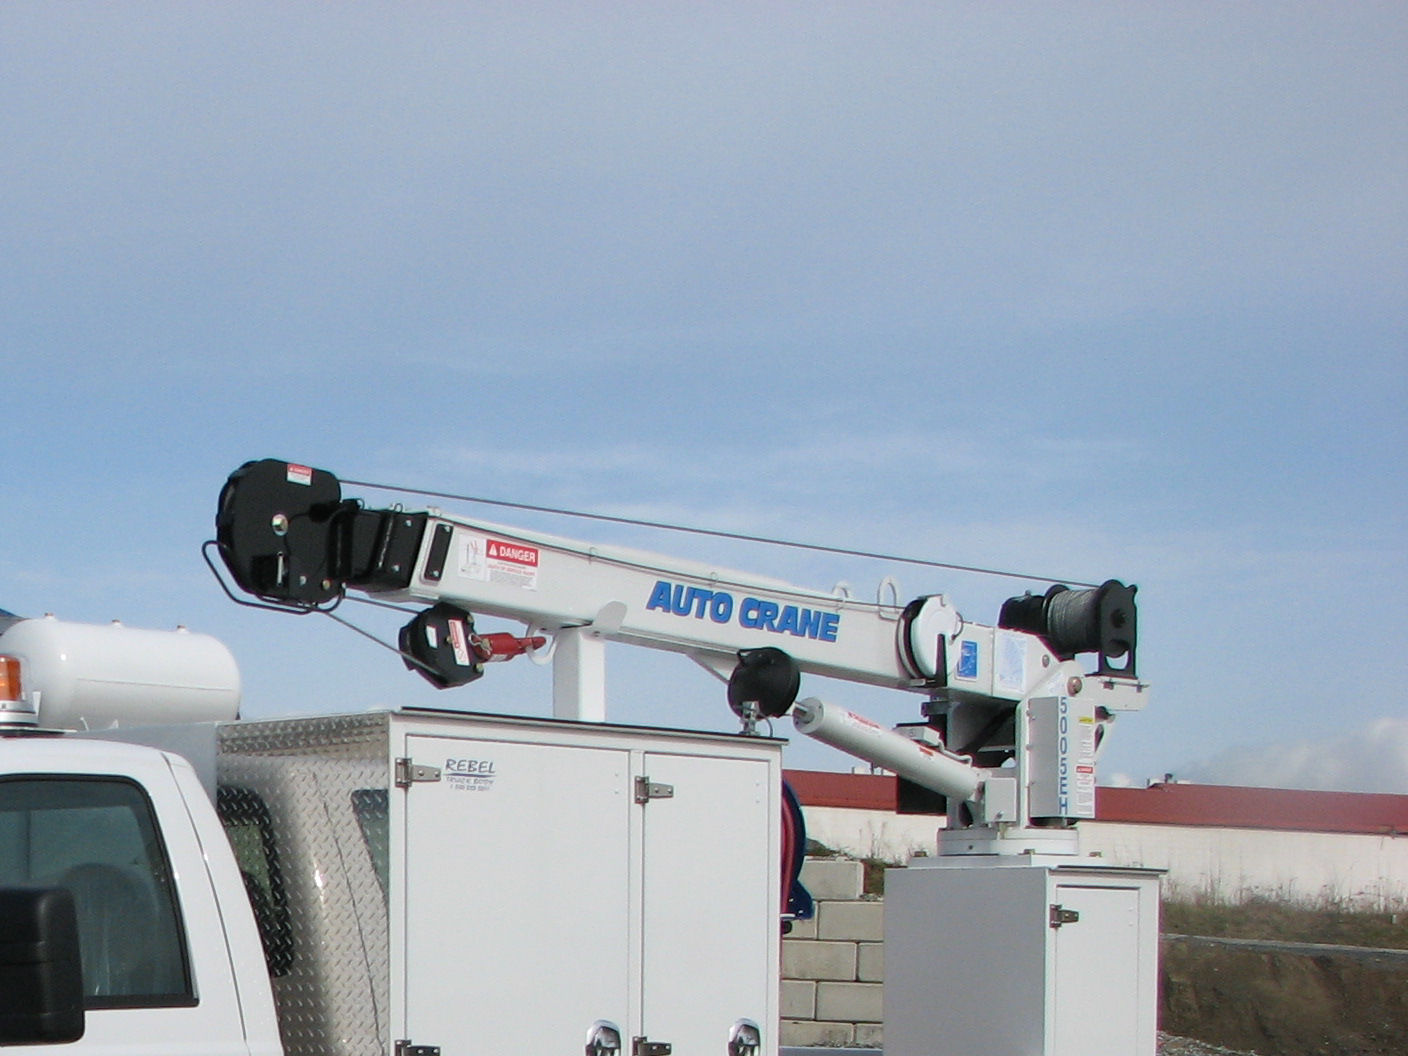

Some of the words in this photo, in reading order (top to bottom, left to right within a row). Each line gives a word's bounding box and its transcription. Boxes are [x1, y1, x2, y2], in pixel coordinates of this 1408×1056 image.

[499, 546, 536, 563] DANGER
[645, 580, 733, 624] AUTO
[738, 597, 841, 643] CRANE
[445, 758, 496, 774] REBEL
